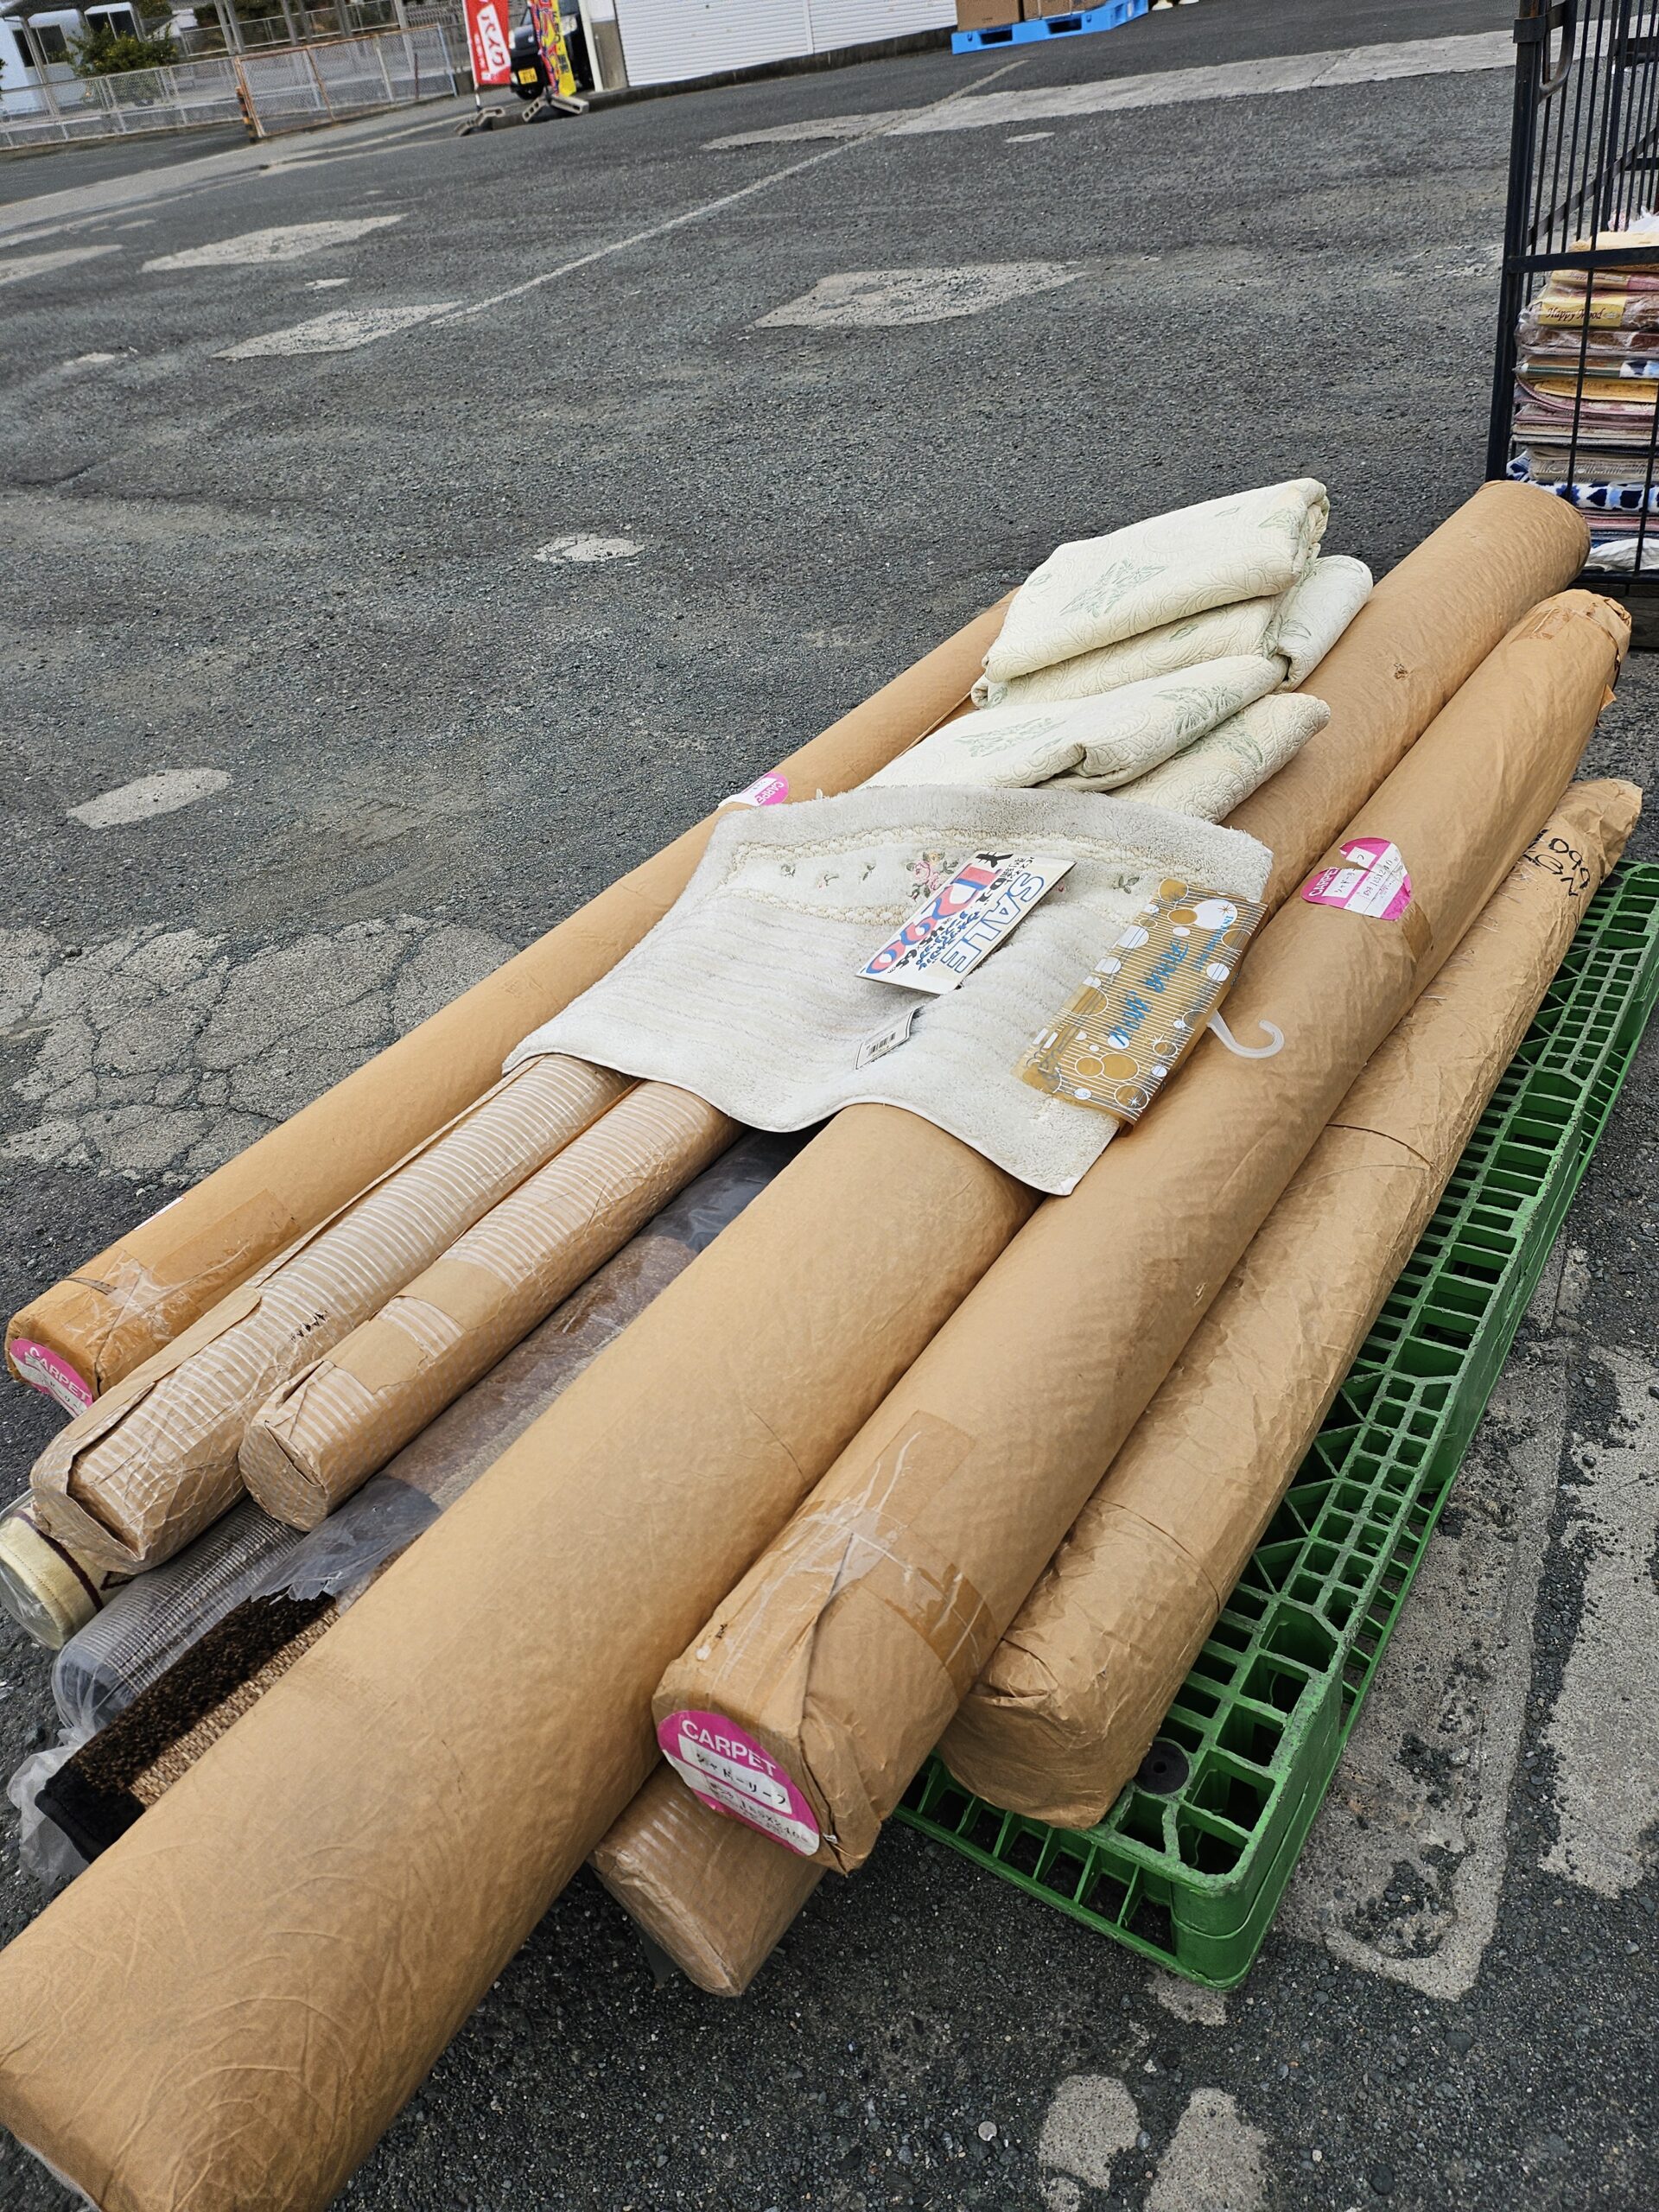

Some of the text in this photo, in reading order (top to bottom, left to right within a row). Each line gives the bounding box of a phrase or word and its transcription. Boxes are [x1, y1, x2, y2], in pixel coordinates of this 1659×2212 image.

[1546, 307, 1575, 321] Happy
[1576, 308, 1605, 321] Mod
[940, 872, 1045, 974] SALE
[29, 1346, 91, 1402] CARPET
[682, 1719, 776, 1777] CARPET
